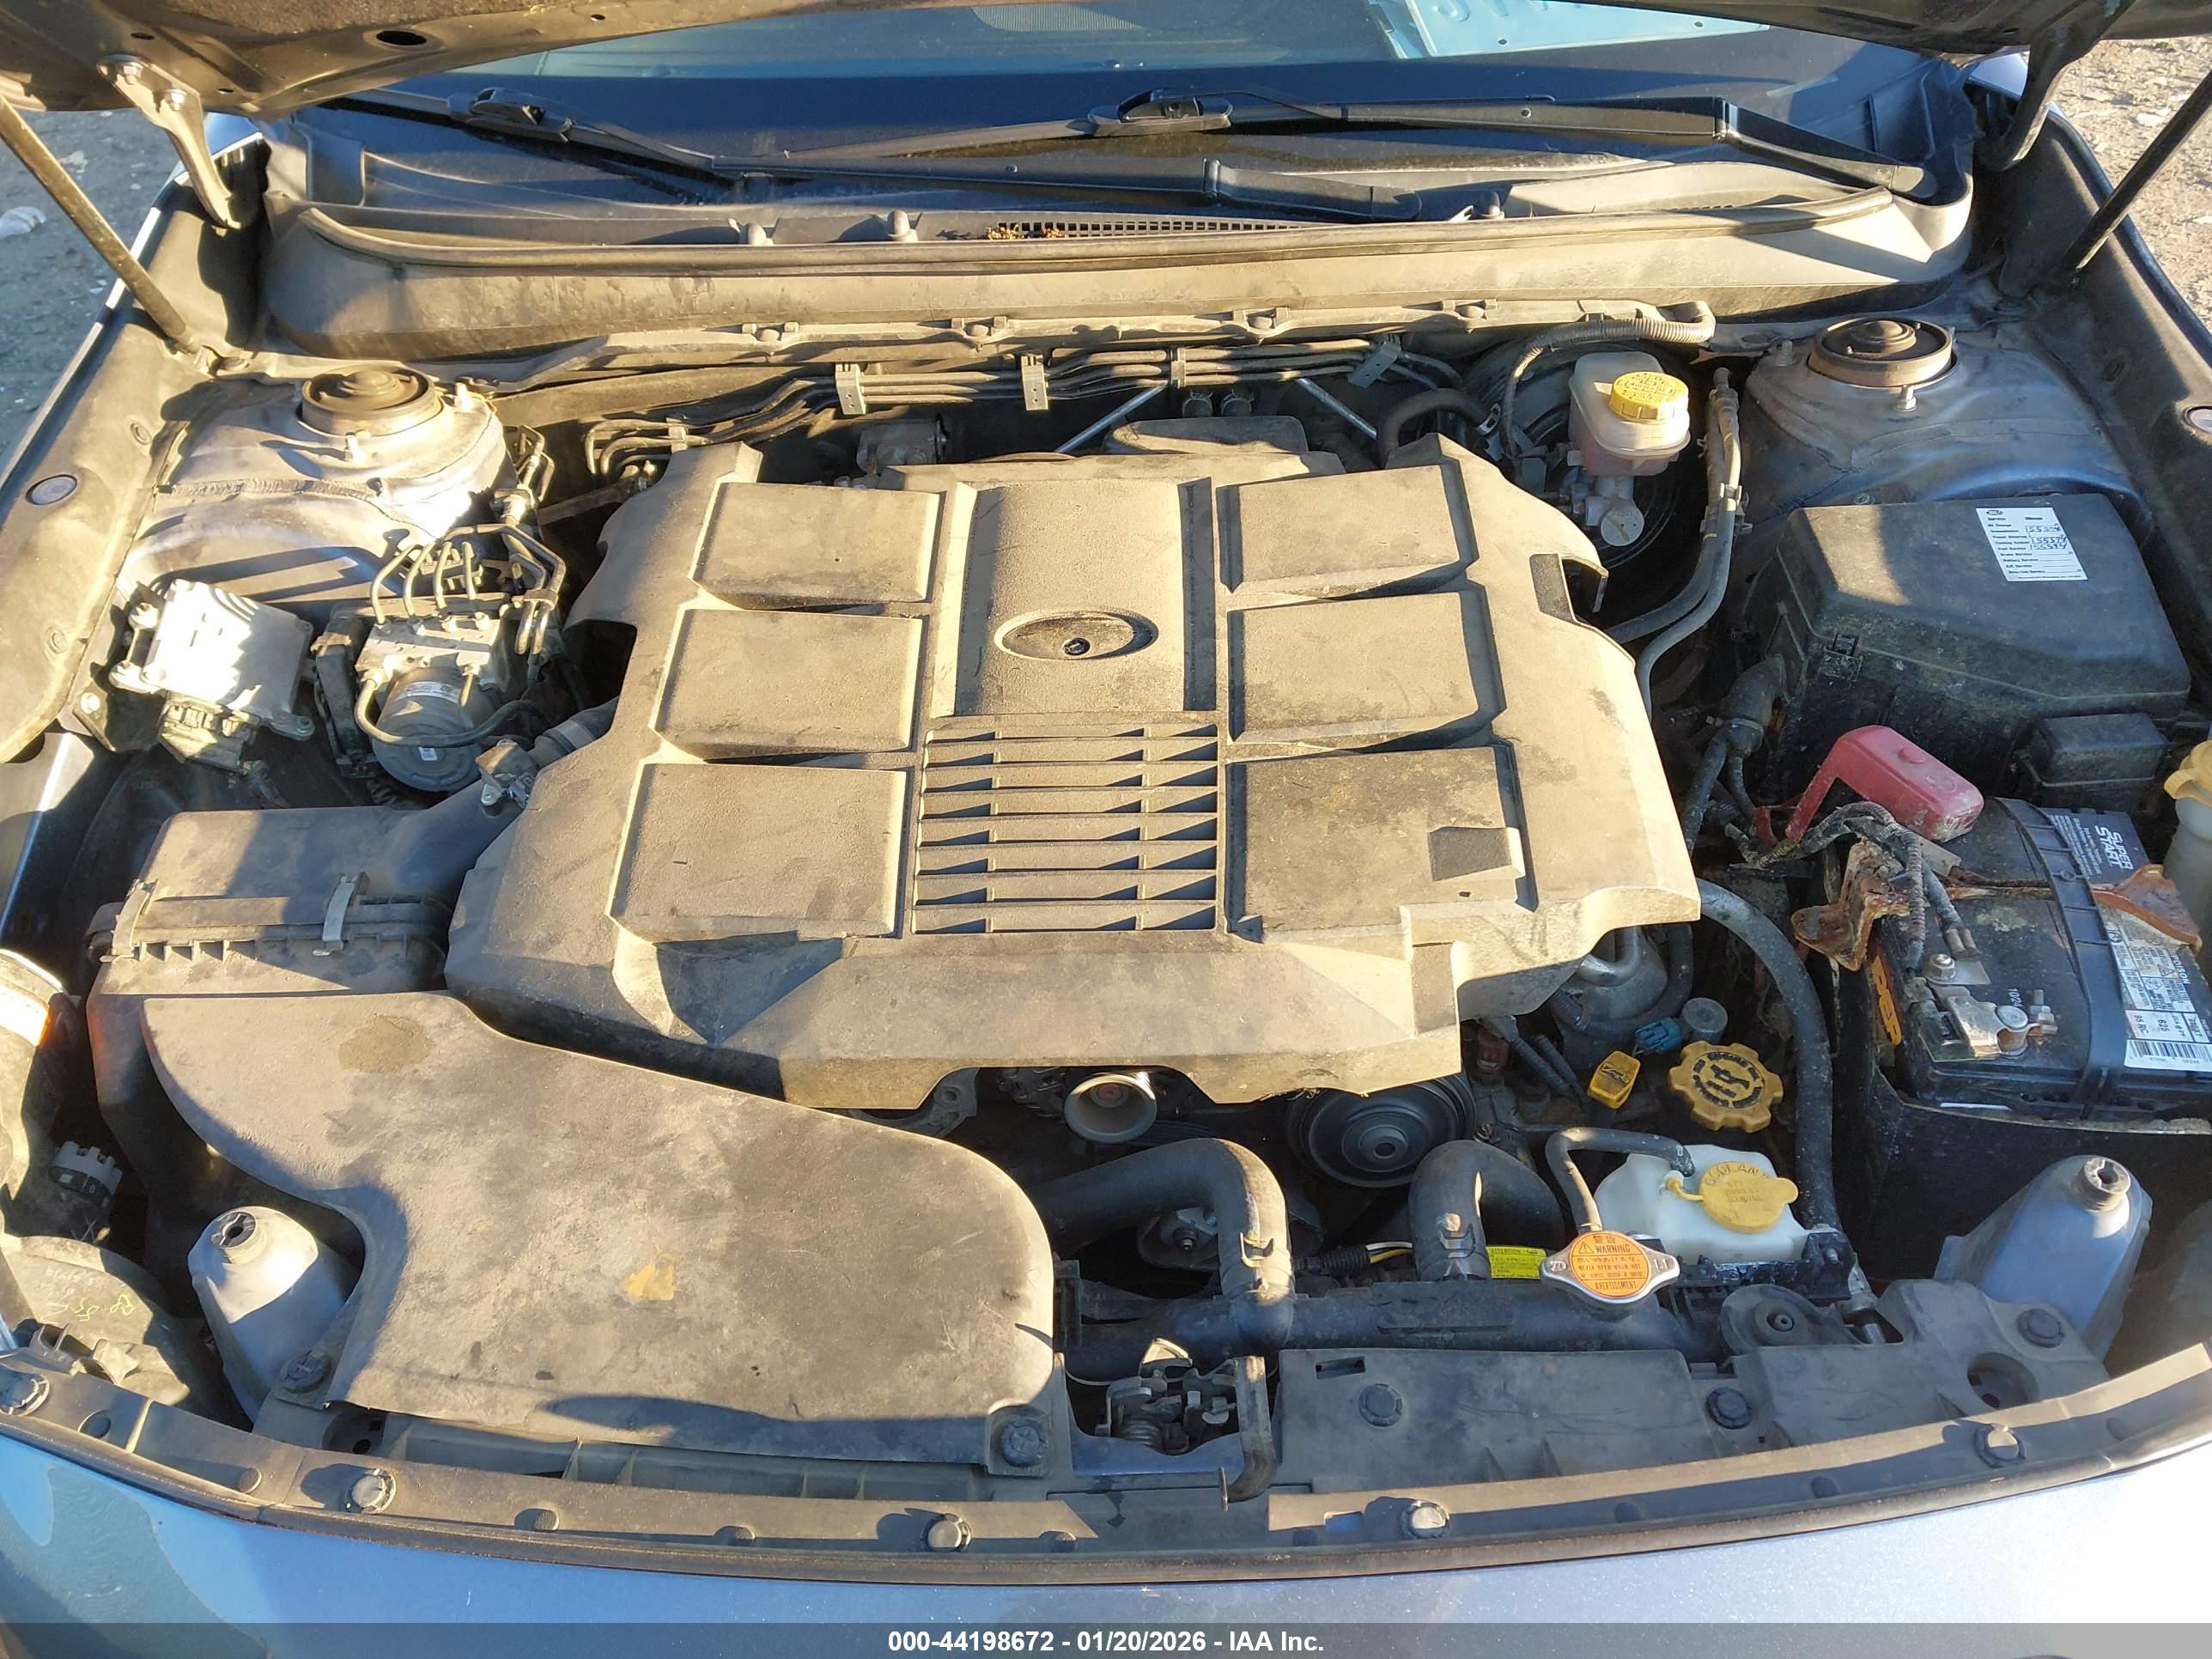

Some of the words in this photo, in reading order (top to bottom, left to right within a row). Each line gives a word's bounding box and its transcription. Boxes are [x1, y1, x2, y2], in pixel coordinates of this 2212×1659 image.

[2095, 825, 2122, 867] START
[2112, 831, 2134, 870] SUPER
[2171, 954, 2191, 984] POISON
[1595, 1244, 1632, 1254] WARNING
